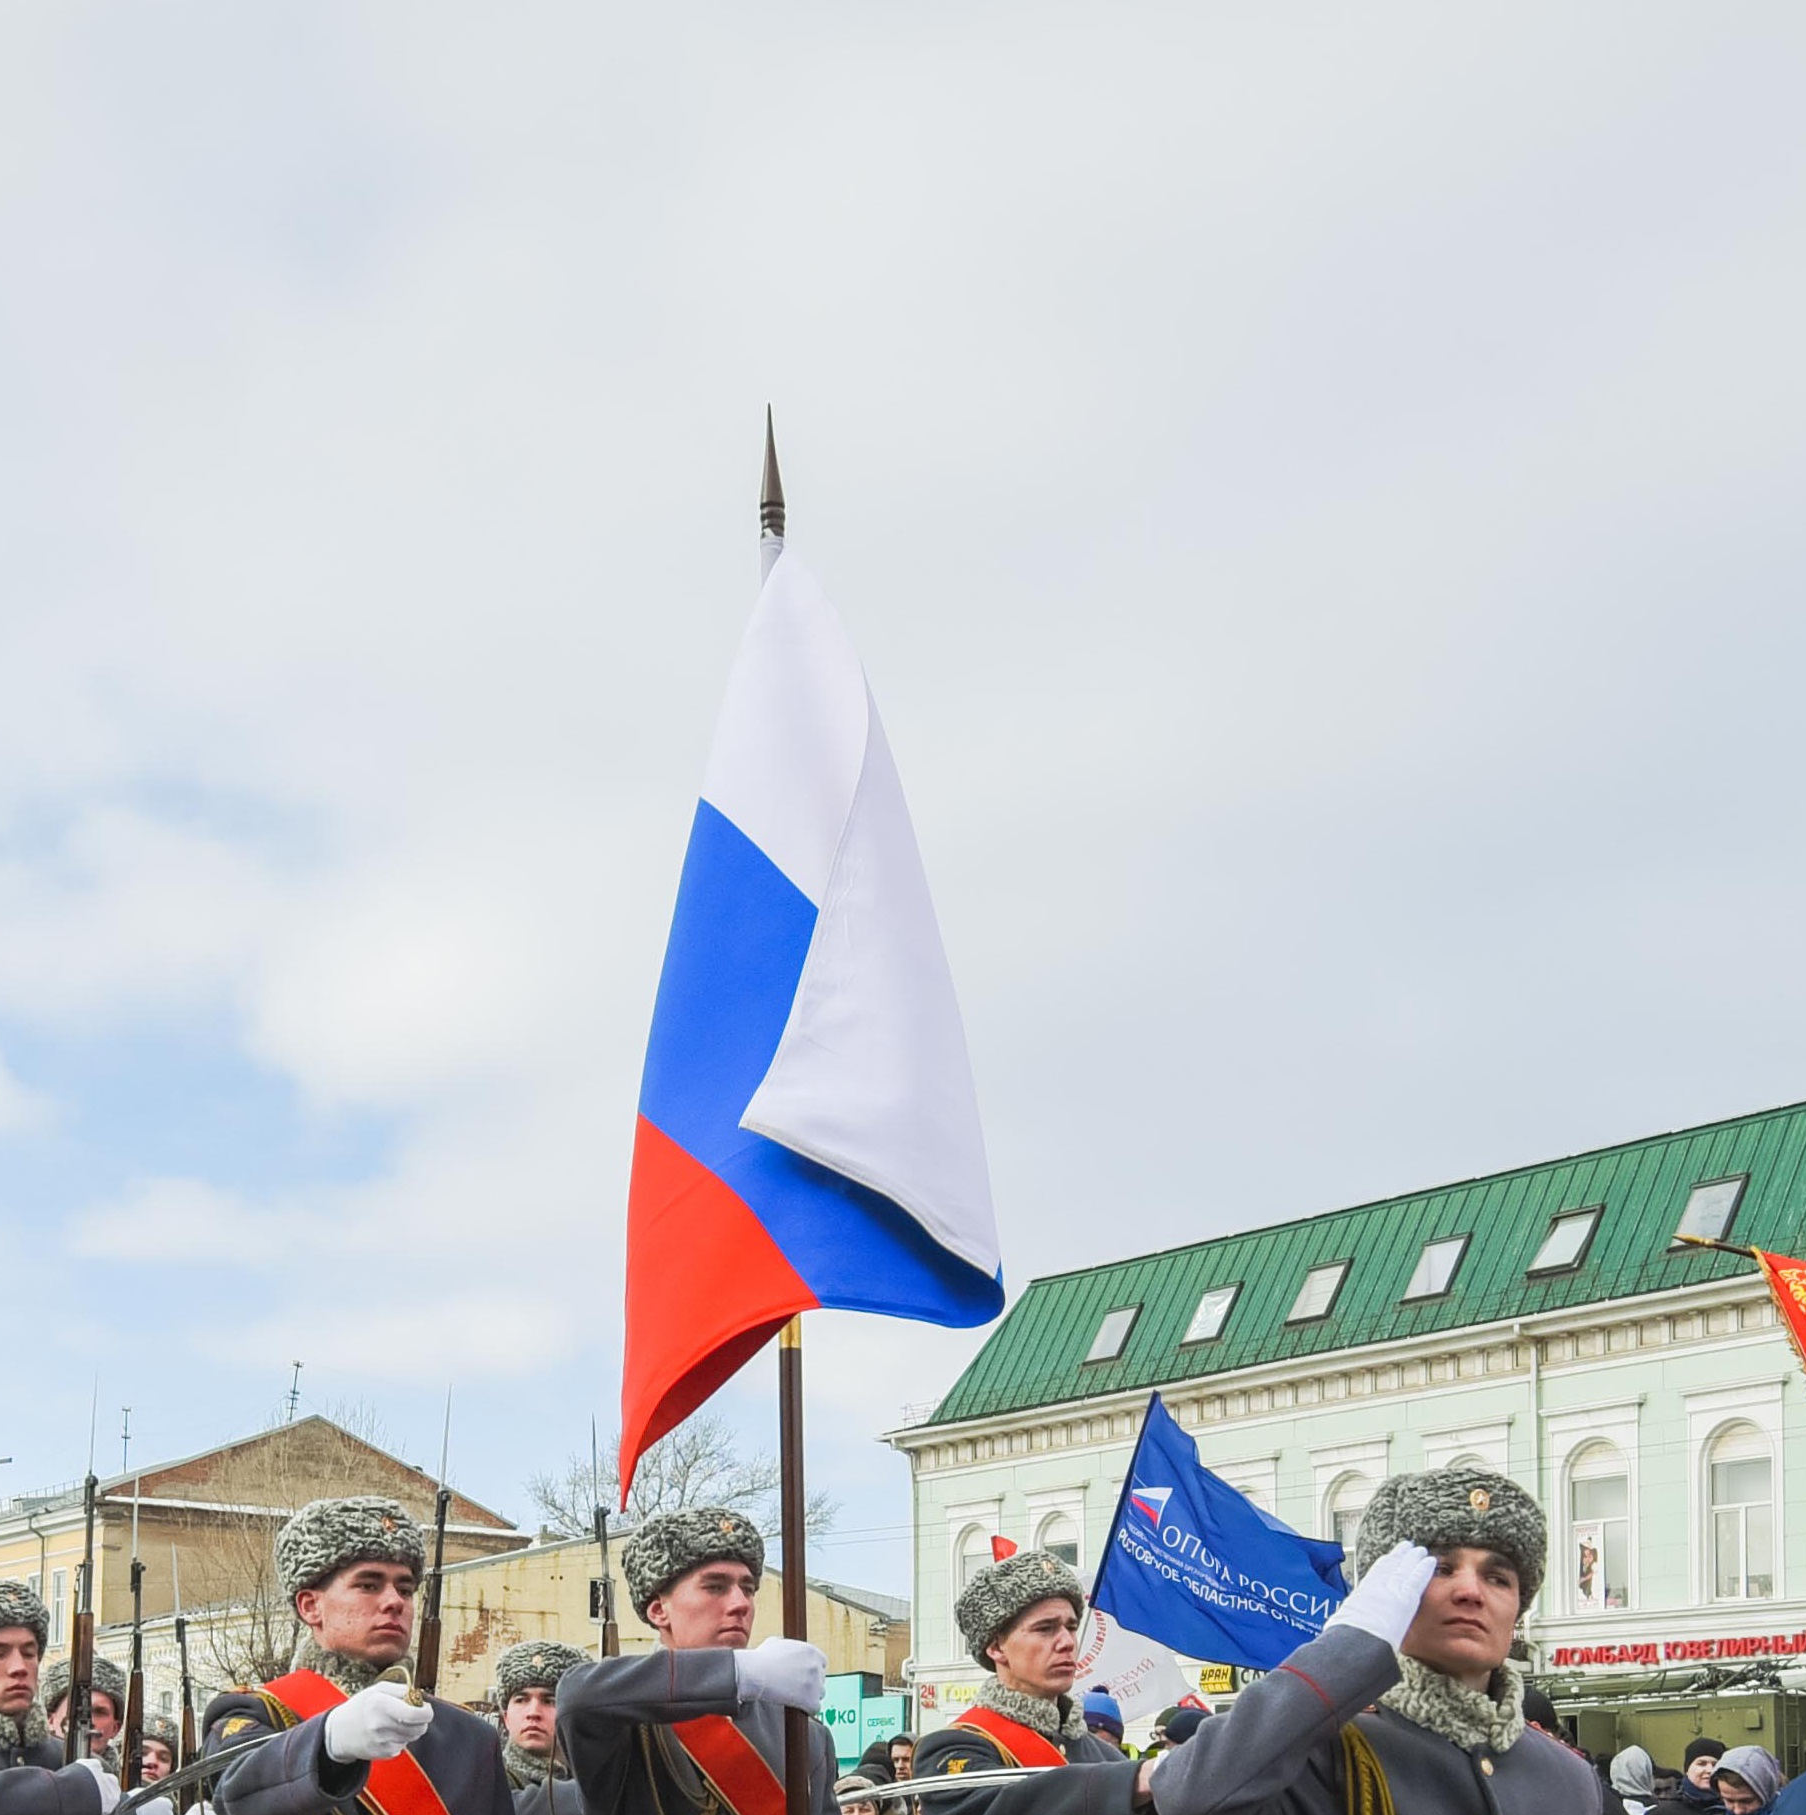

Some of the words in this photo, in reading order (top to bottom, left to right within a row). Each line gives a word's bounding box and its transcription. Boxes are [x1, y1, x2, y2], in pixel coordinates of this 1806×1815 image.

[1239, 1573, 1344, 1619] РОССИ
[1552, 1642, 1660, 1667] ЛОМБАРД
[921, 1684, 936, 1699] 24
[867, 1717, 896, 1728] СЕРВИС
